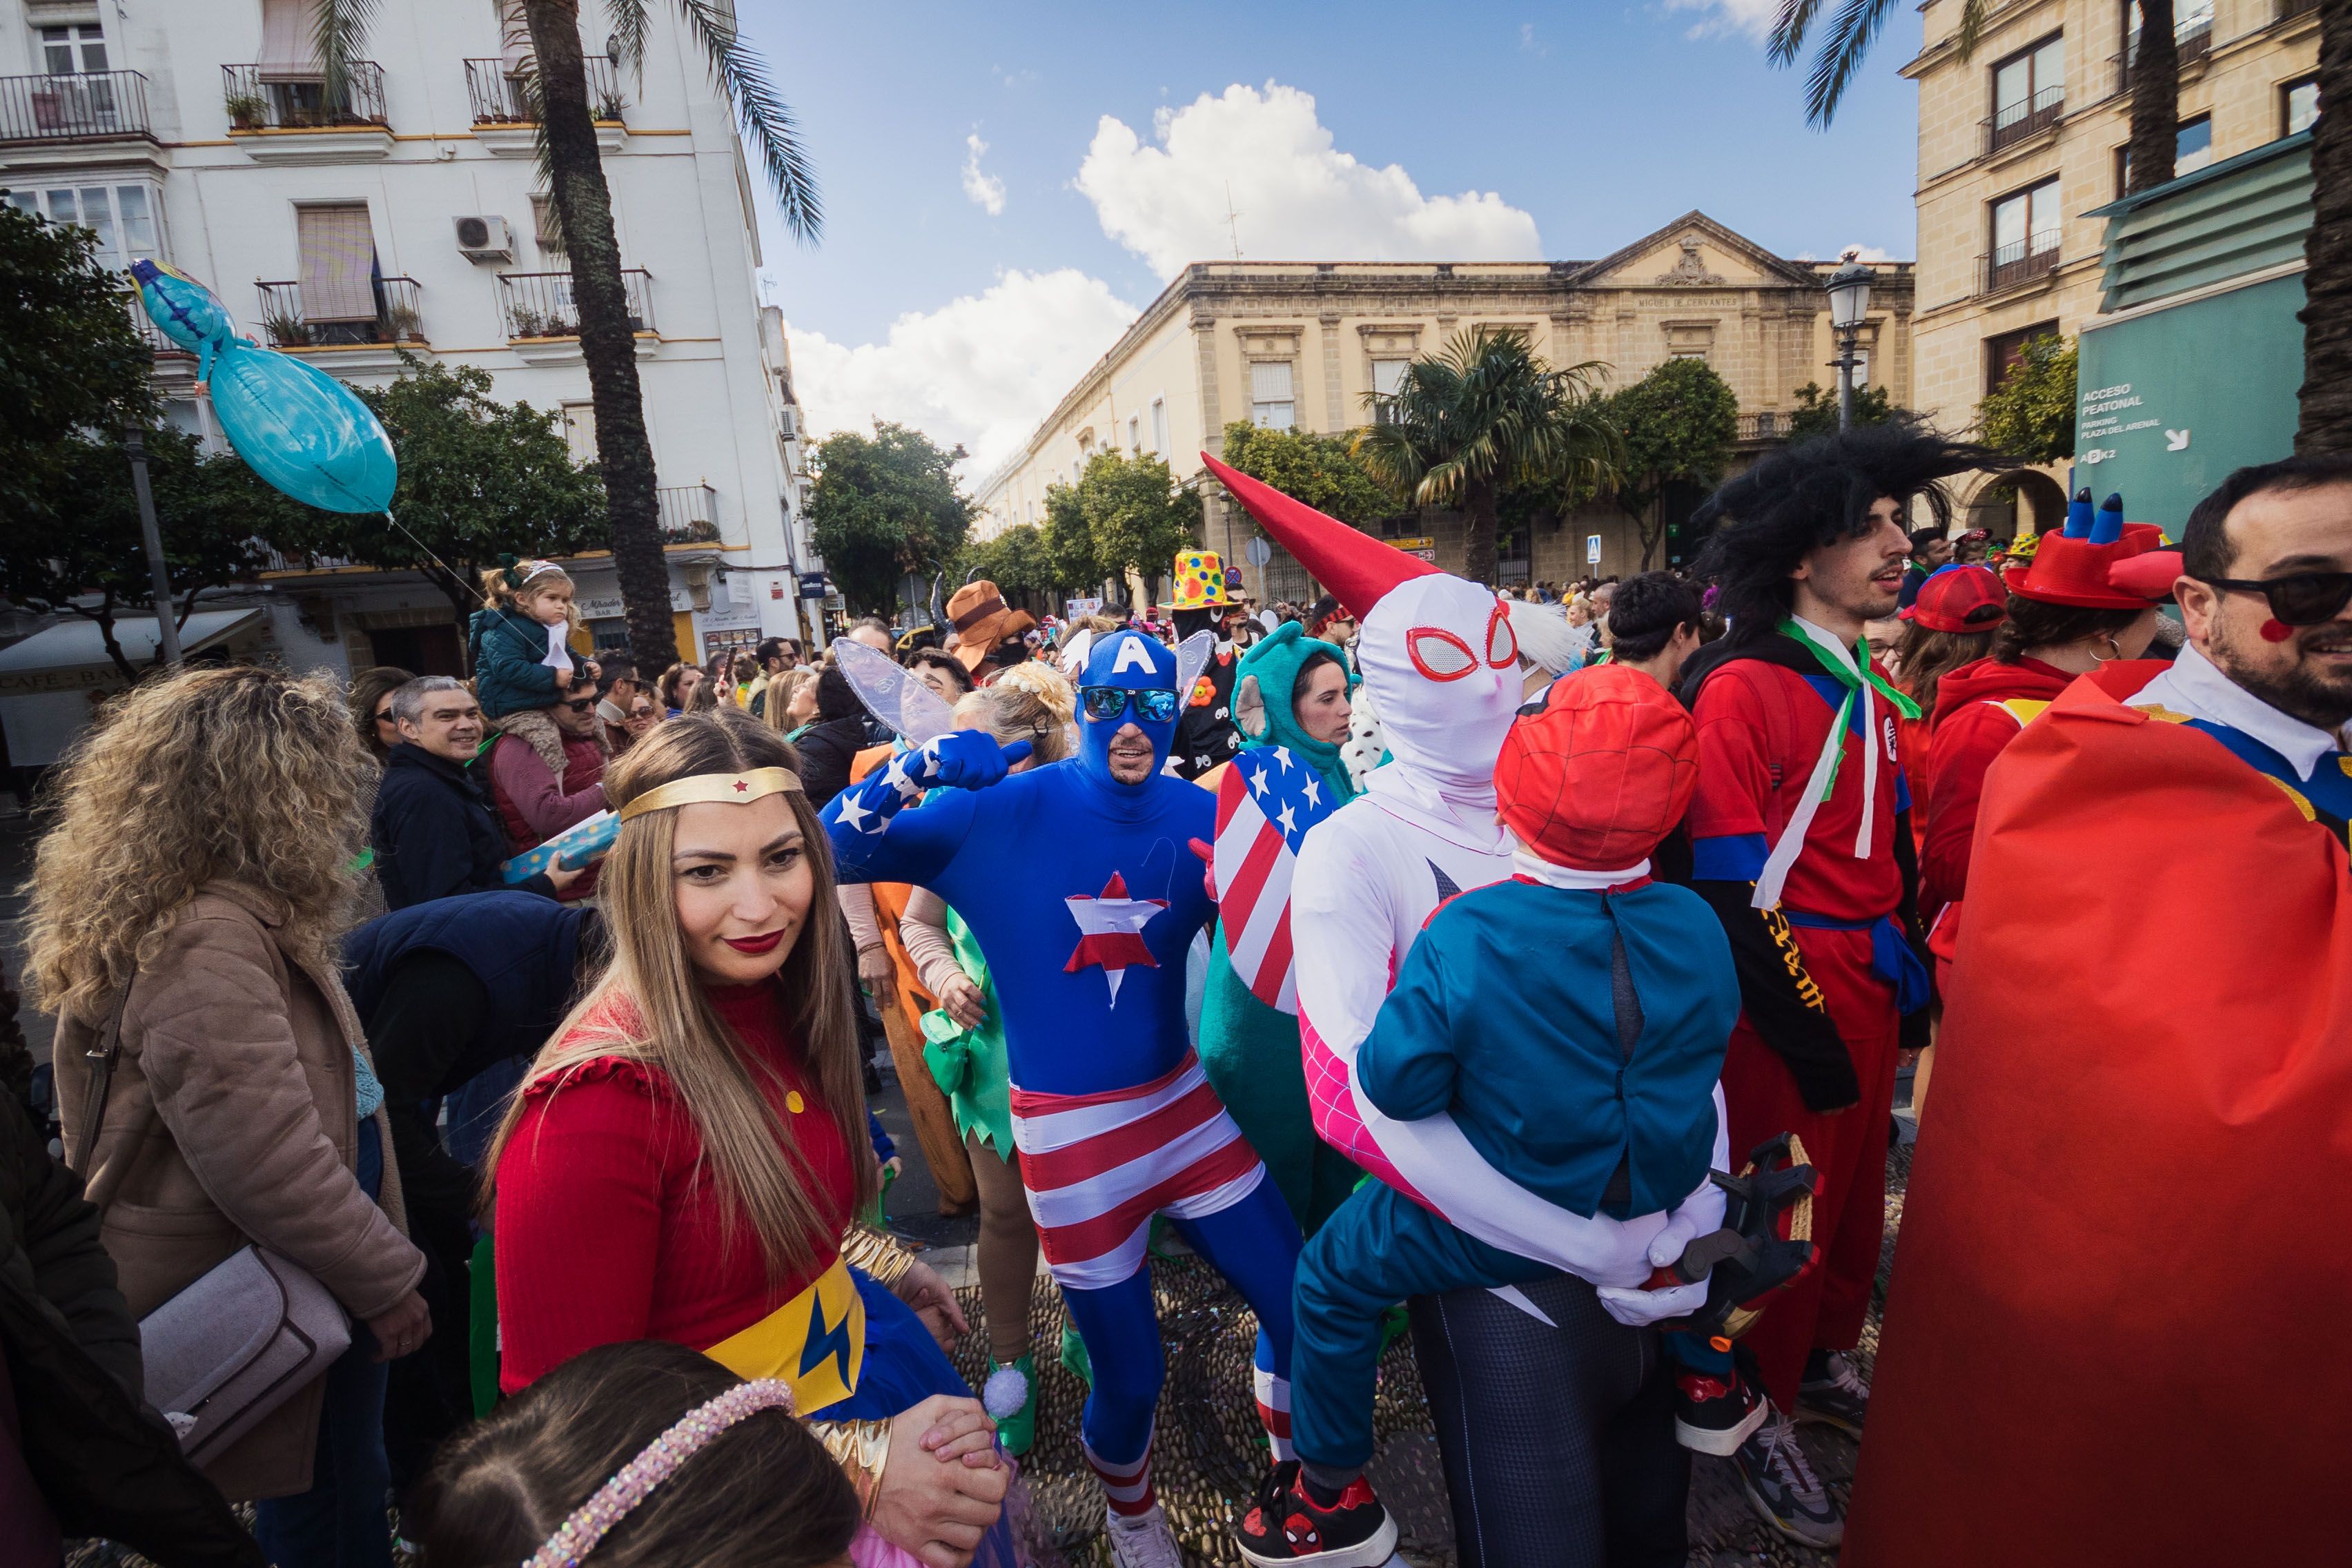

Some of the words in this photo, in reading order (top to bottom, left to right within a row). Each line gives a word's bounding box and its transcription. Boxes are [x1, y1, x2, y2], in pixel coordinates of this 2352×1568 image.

[1638, 297, 1669, 307] MIGUEL
[1674, 297, 1683, 307] DE
[1687, 297, 1737, 306] CERVANTES
[2082, 383, 2131, 402] ACCESO
[2082, 395, 2144, 416] PEATONAL
[2081, 416, 2117, 430] PARKING
[2081, 429, 2106, 440] PLAZA
[2108, 425, 2125, 435] DEL
[2126, 418, 2162, 431] ARENAL
[581, 598, 620, 611] Mirador
[1112, 636, 1157, 674] A
[0, 671, 57, 689] CAFÉ
